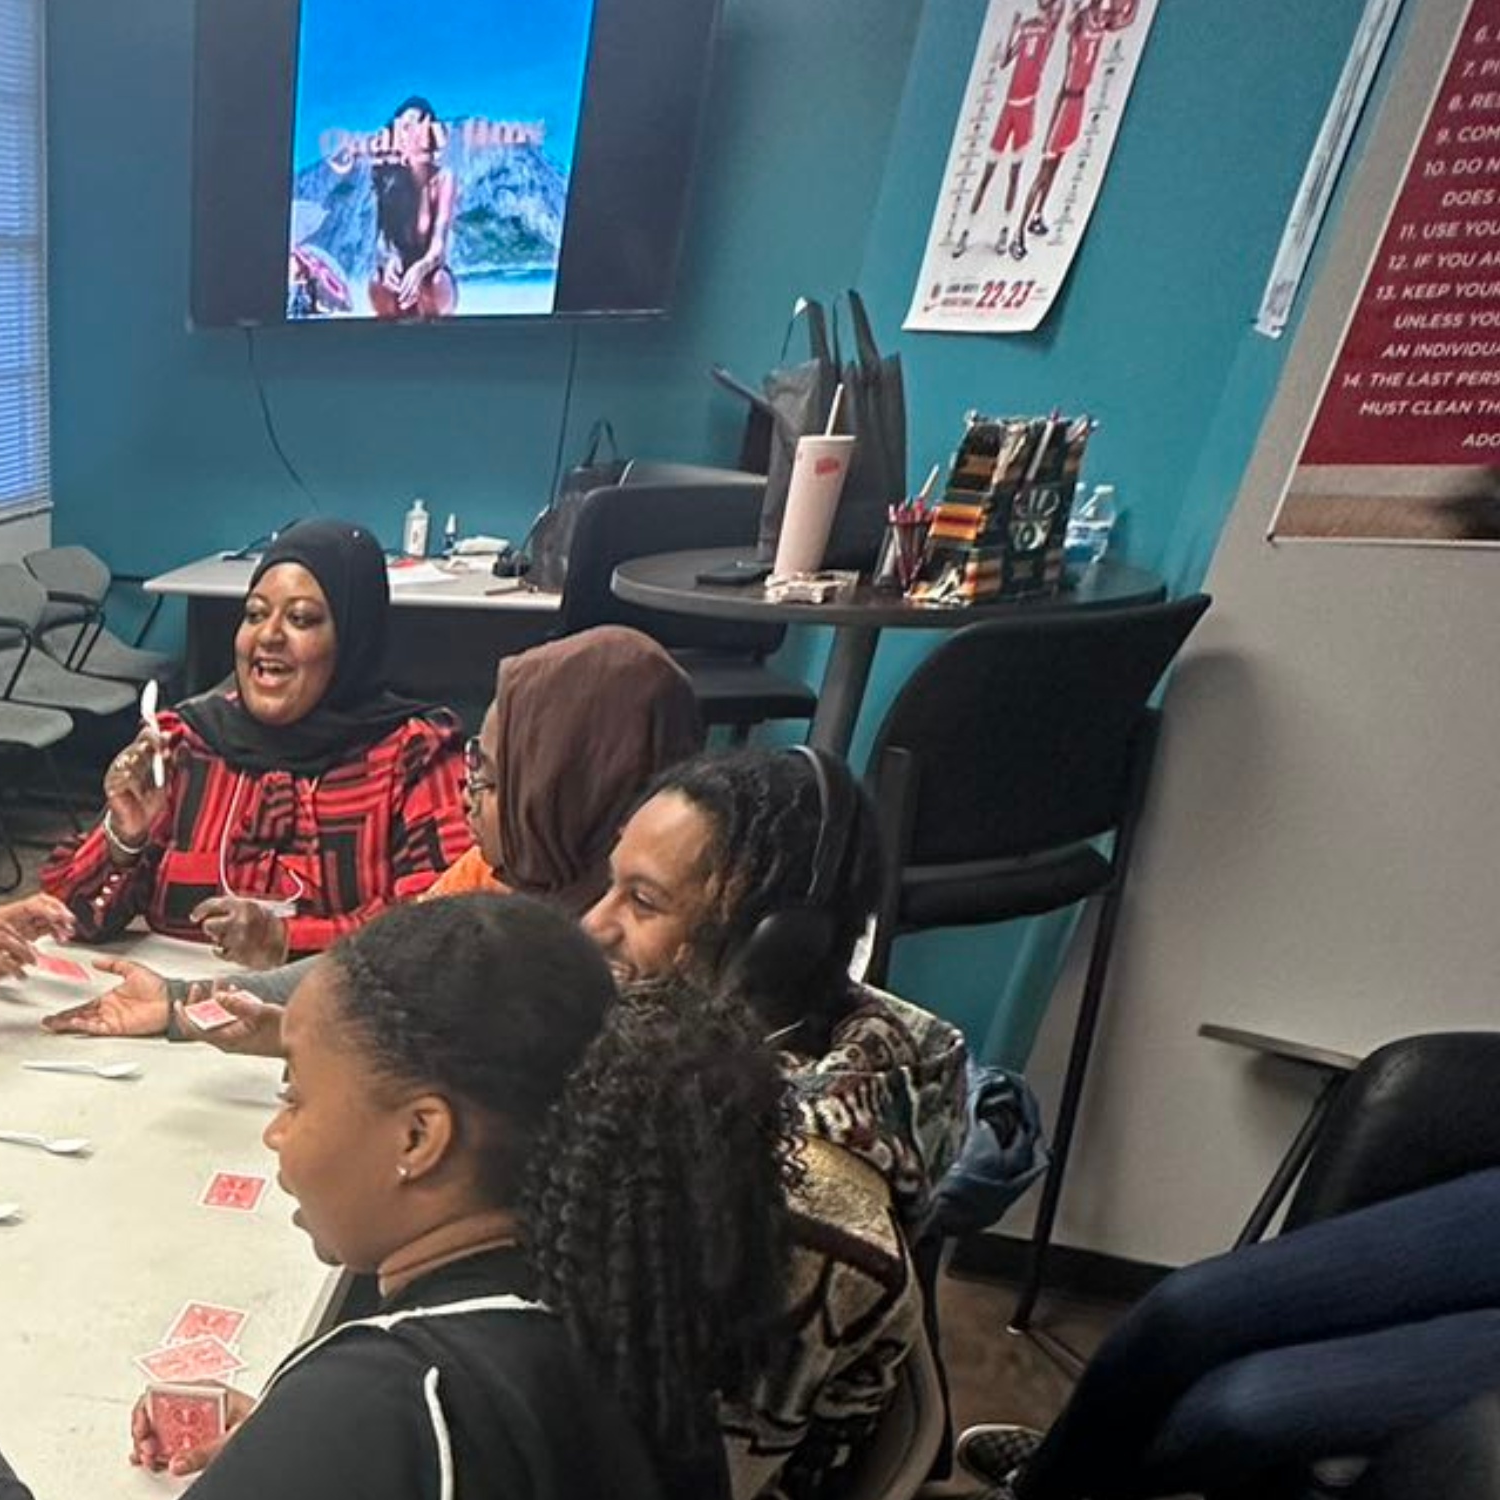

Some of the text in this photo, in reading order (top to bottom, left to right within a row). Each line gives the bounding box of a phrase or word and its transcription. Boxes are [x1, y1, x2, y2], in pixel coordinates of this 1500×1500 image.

[1452, 158, 1483, 175] DO
[1442, 189, 1495, 207] DOES
[1399, 224, 1416, 241] 11.
[1423, 222, 1460, 240] USE
[1388, 255, 1408, 271] 12.
[1413, 254, 1433, 270] IF
[1437, 252, 1477, 269] YOU
[975, 279, 1036, 309] 22-23
[1376, 286, 1397, 300] 13.
[1402, 283, 1451, 299] KEEP
[1393, 314, 1464, 330] UNLESS
[1381, 344, 1411, 359] AN
[1369, 372, 1405, 387] THE
[1407, 371, 1452, 387] LAST
[1359, 400, 1408, 416] MUST
[1411, 400, 1473, 416] CLEAN
